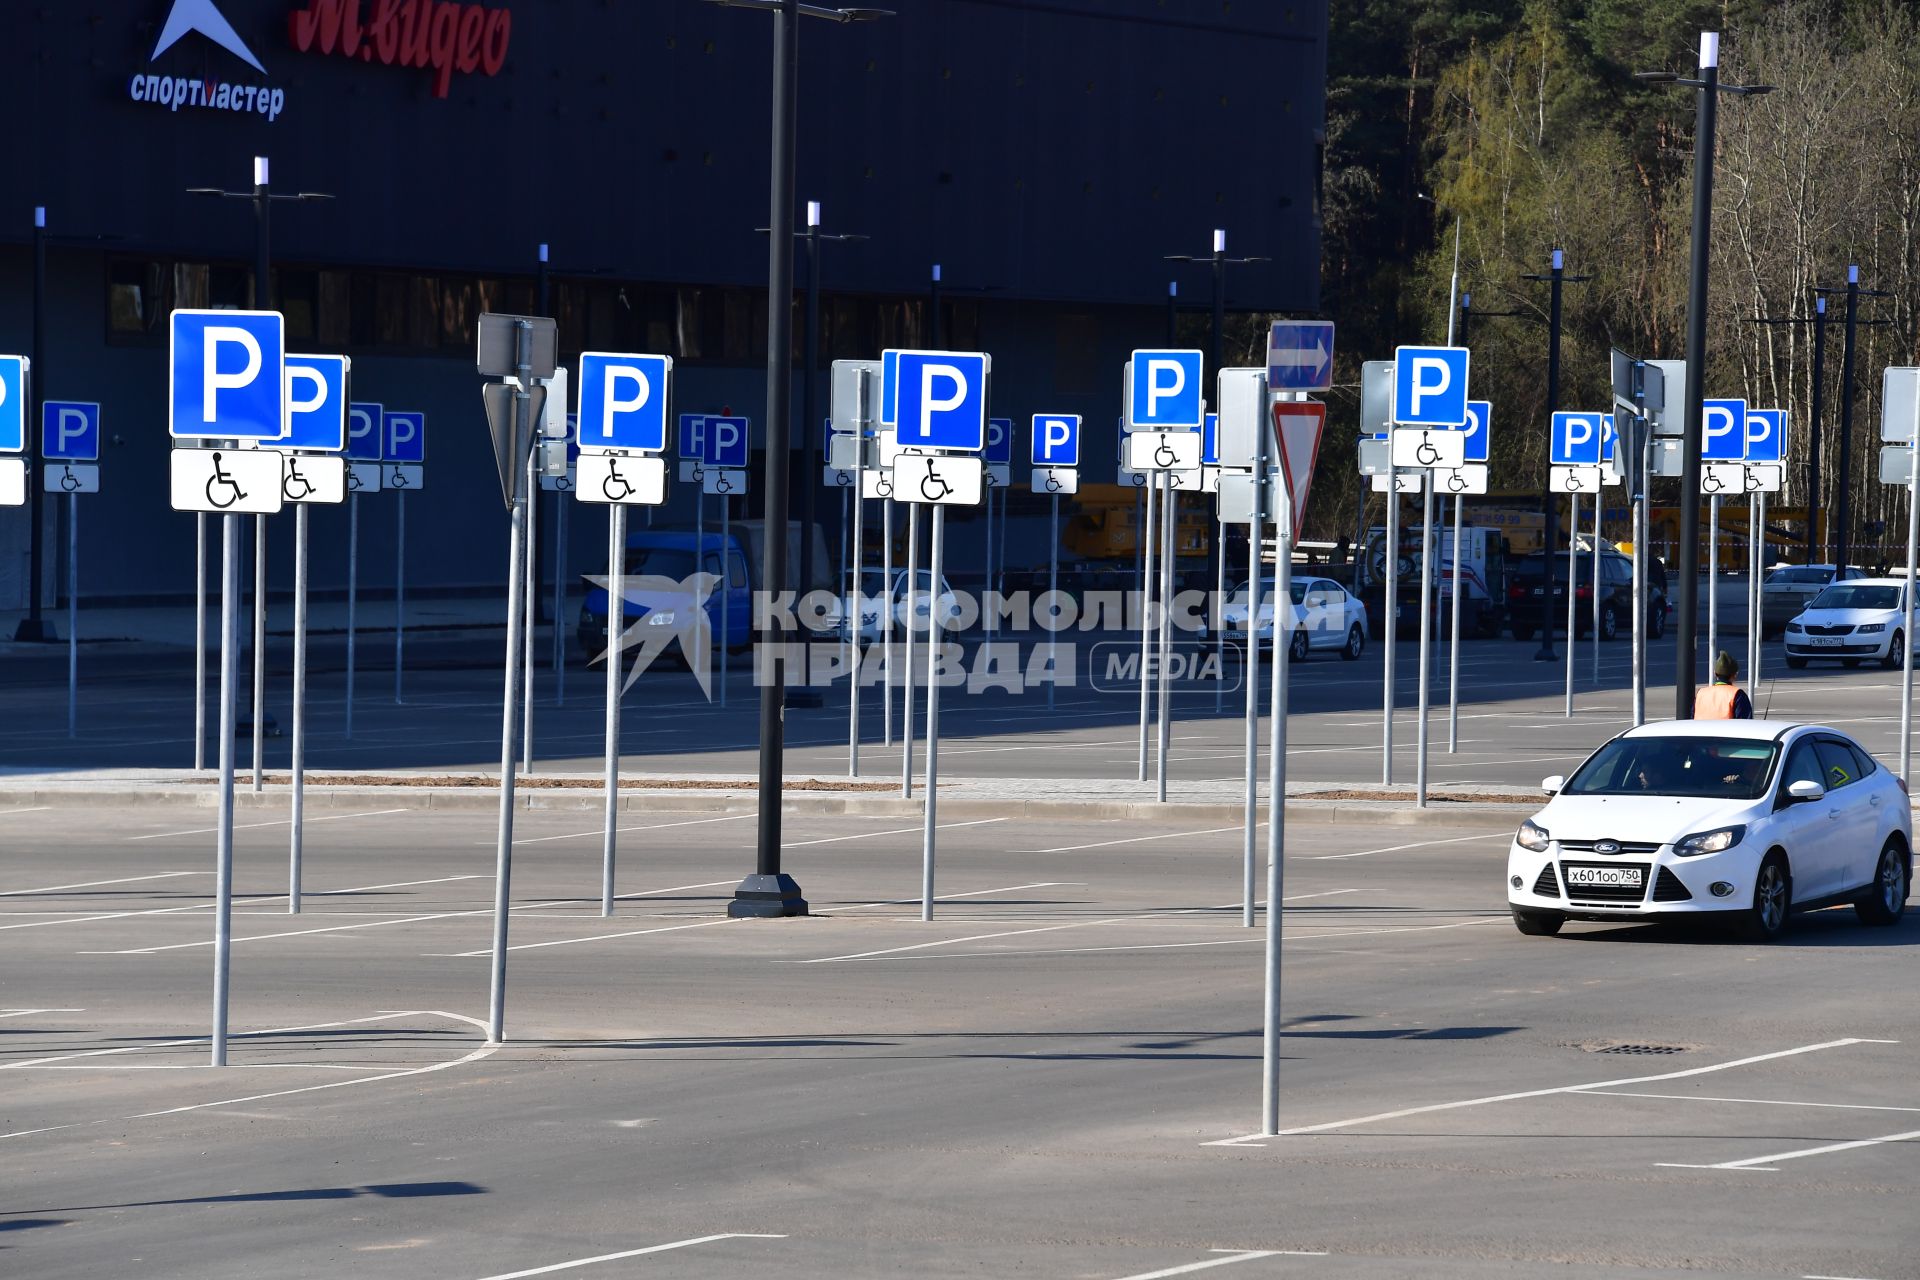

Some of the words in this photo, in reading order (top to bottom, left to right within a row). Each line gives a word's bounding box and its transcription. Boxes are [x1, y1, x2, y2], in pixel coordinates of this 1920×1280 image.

[203, 326, 262, 422] P
[1147, 359, 1186, 417] P
[1410, 357, 1451, 416] P
[284, 366, 328, 438] P
[602, 364, 650, 438] P
[919, 363, 968, 437] P
[58, 408, 88, 452] P
[391, 418, 415, 456] P
[715, 422, 739, 461] P
[1044, 420, 1071, 459] P
[1564, 418, 1592, 458] P
[1701, 406, 1734, 453] P
[1746, 416, 1770, 456] P
[1620, 869, 1639, 880] 750
